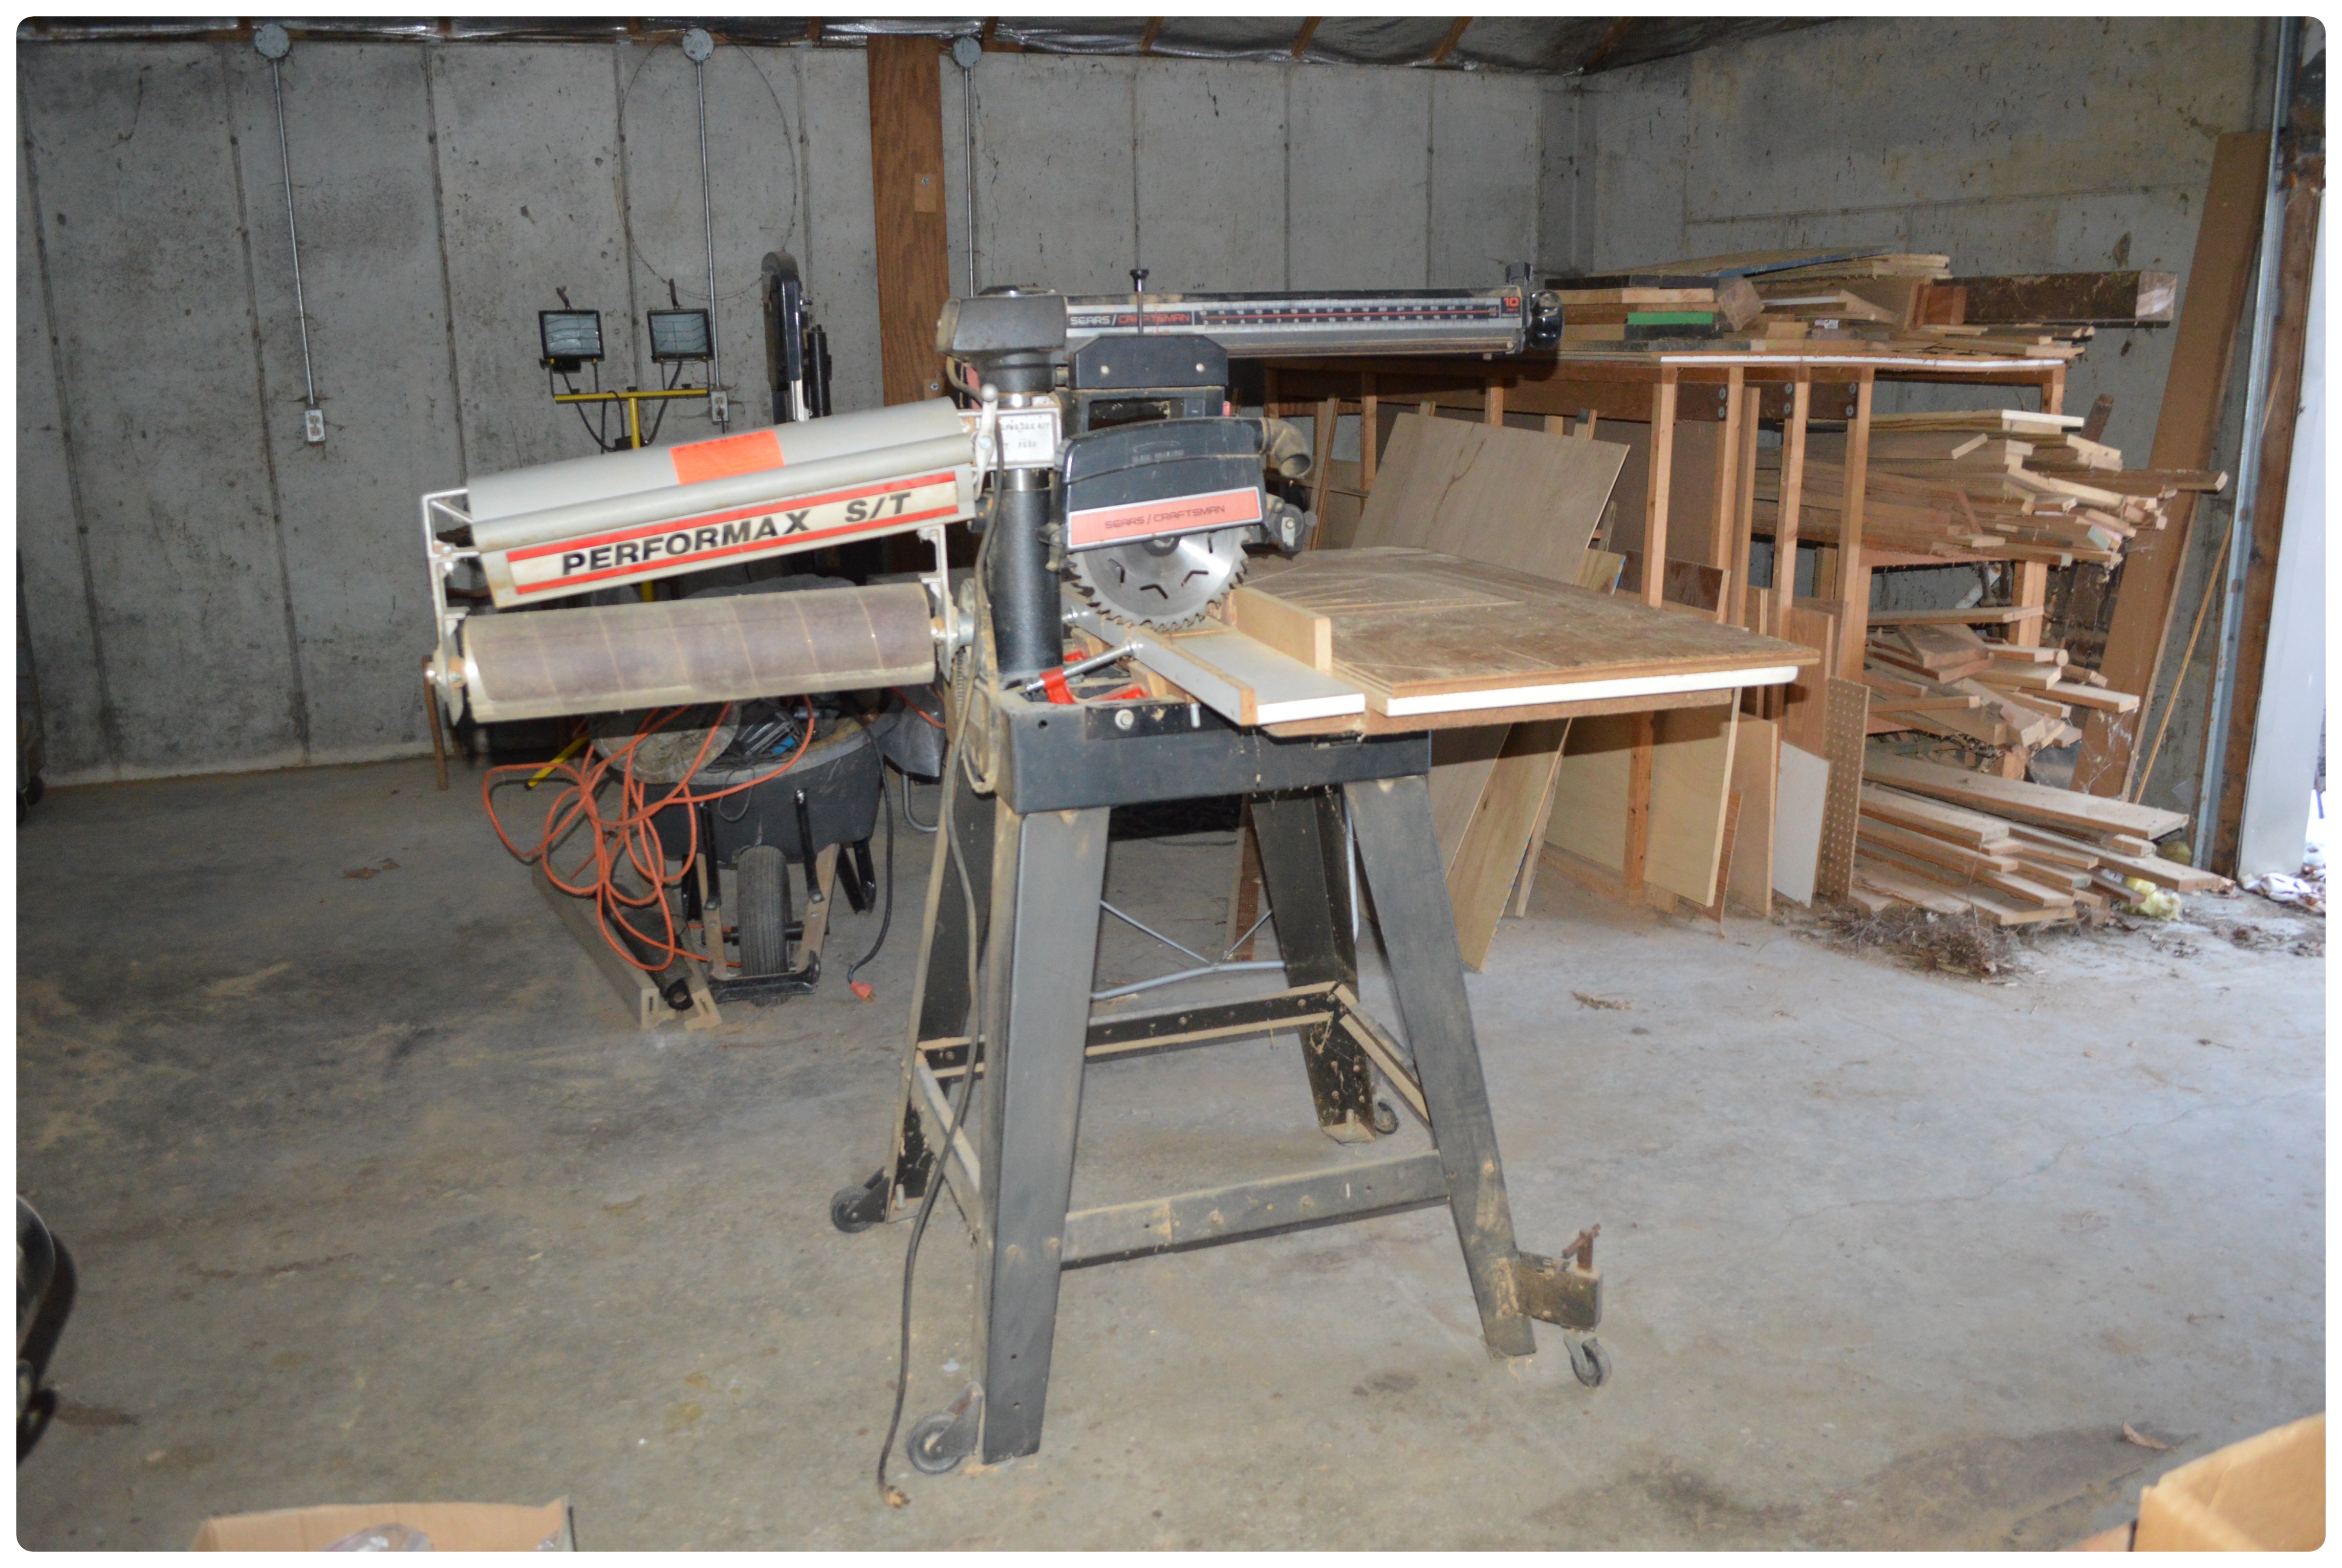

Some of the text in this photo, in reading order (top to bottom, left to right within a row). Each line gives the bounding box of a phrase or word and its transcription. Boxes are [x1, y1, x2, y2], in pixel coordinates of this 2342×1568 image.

[1504, 297, 1520, 306] 10
[1070, 315, 1111, 325] SEARS
[1105, 516, 1144, 529] SEARS
[1153, 505, 1225, 521] CRAFTSMAN
[562, 492, 911, 576] PERFORMAX S/T
